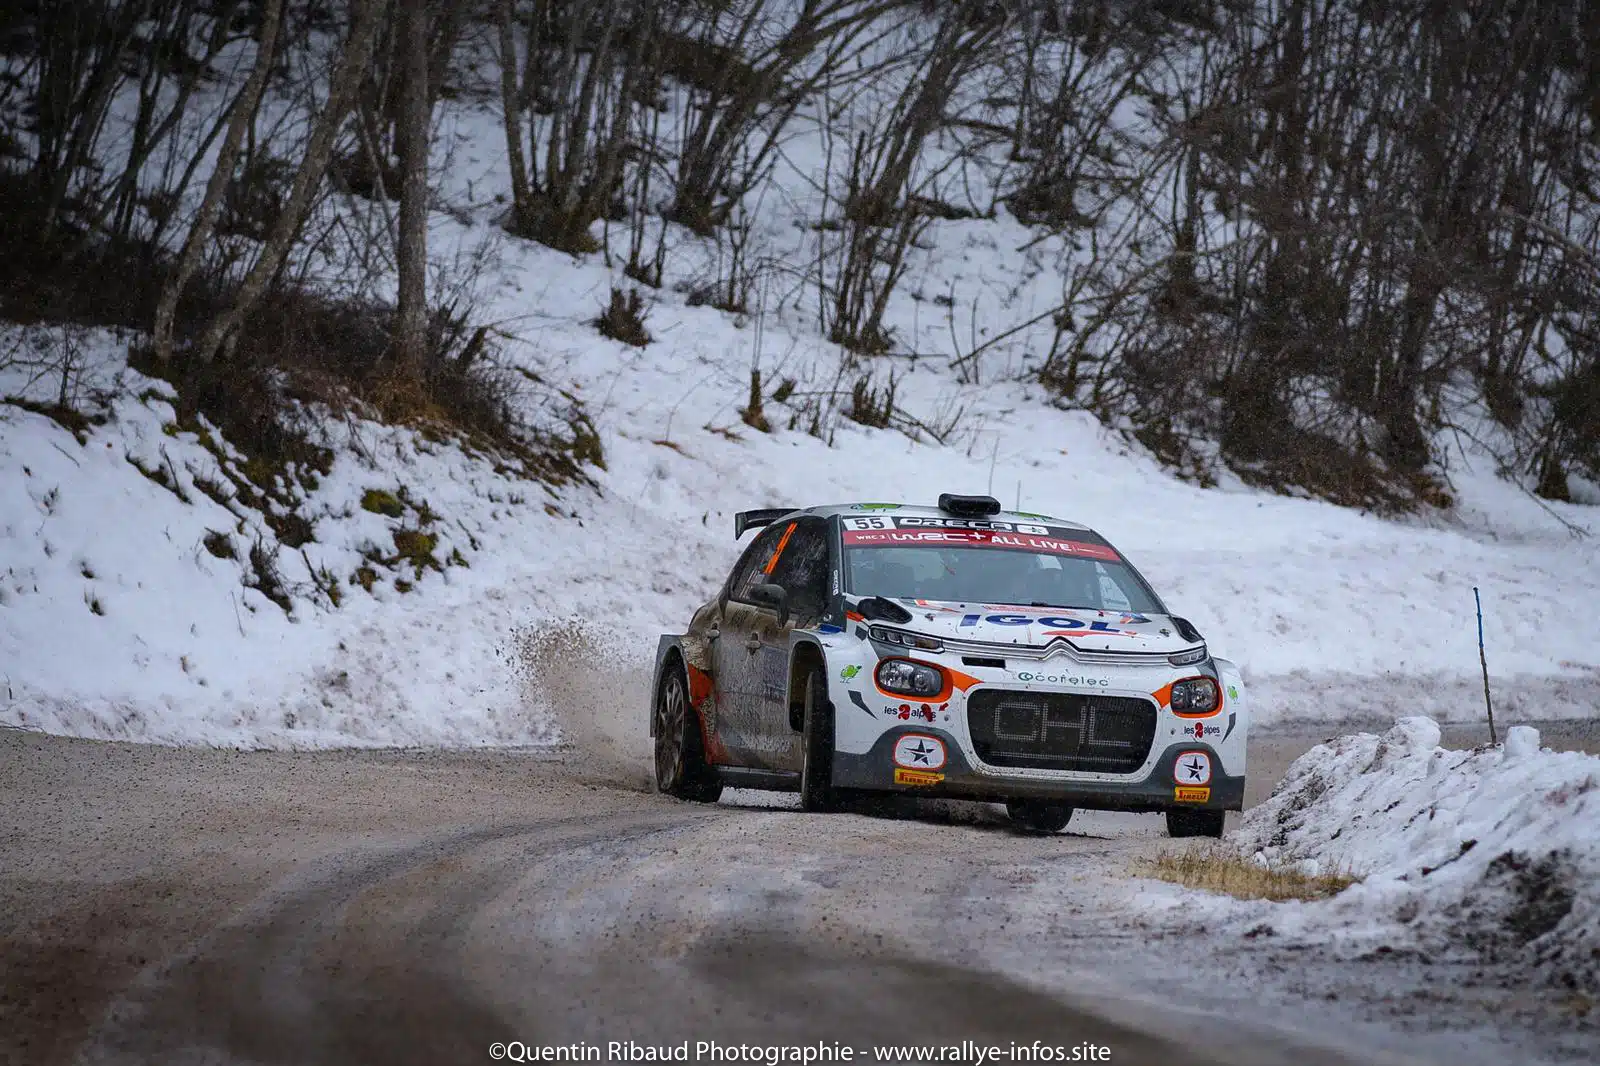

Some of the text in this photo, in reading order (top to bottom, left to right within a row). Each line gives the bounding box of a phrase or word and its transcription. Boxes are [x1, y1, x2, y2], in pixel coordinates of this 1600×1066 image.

[854, 517, 885, 529] 55
[991, 535, 1026, 546] ALL
[1029, 539, 1071, 551] LIVE
[960, 614, 1120, 632] IGOL
[994, 702, 1130, 747] CHL
